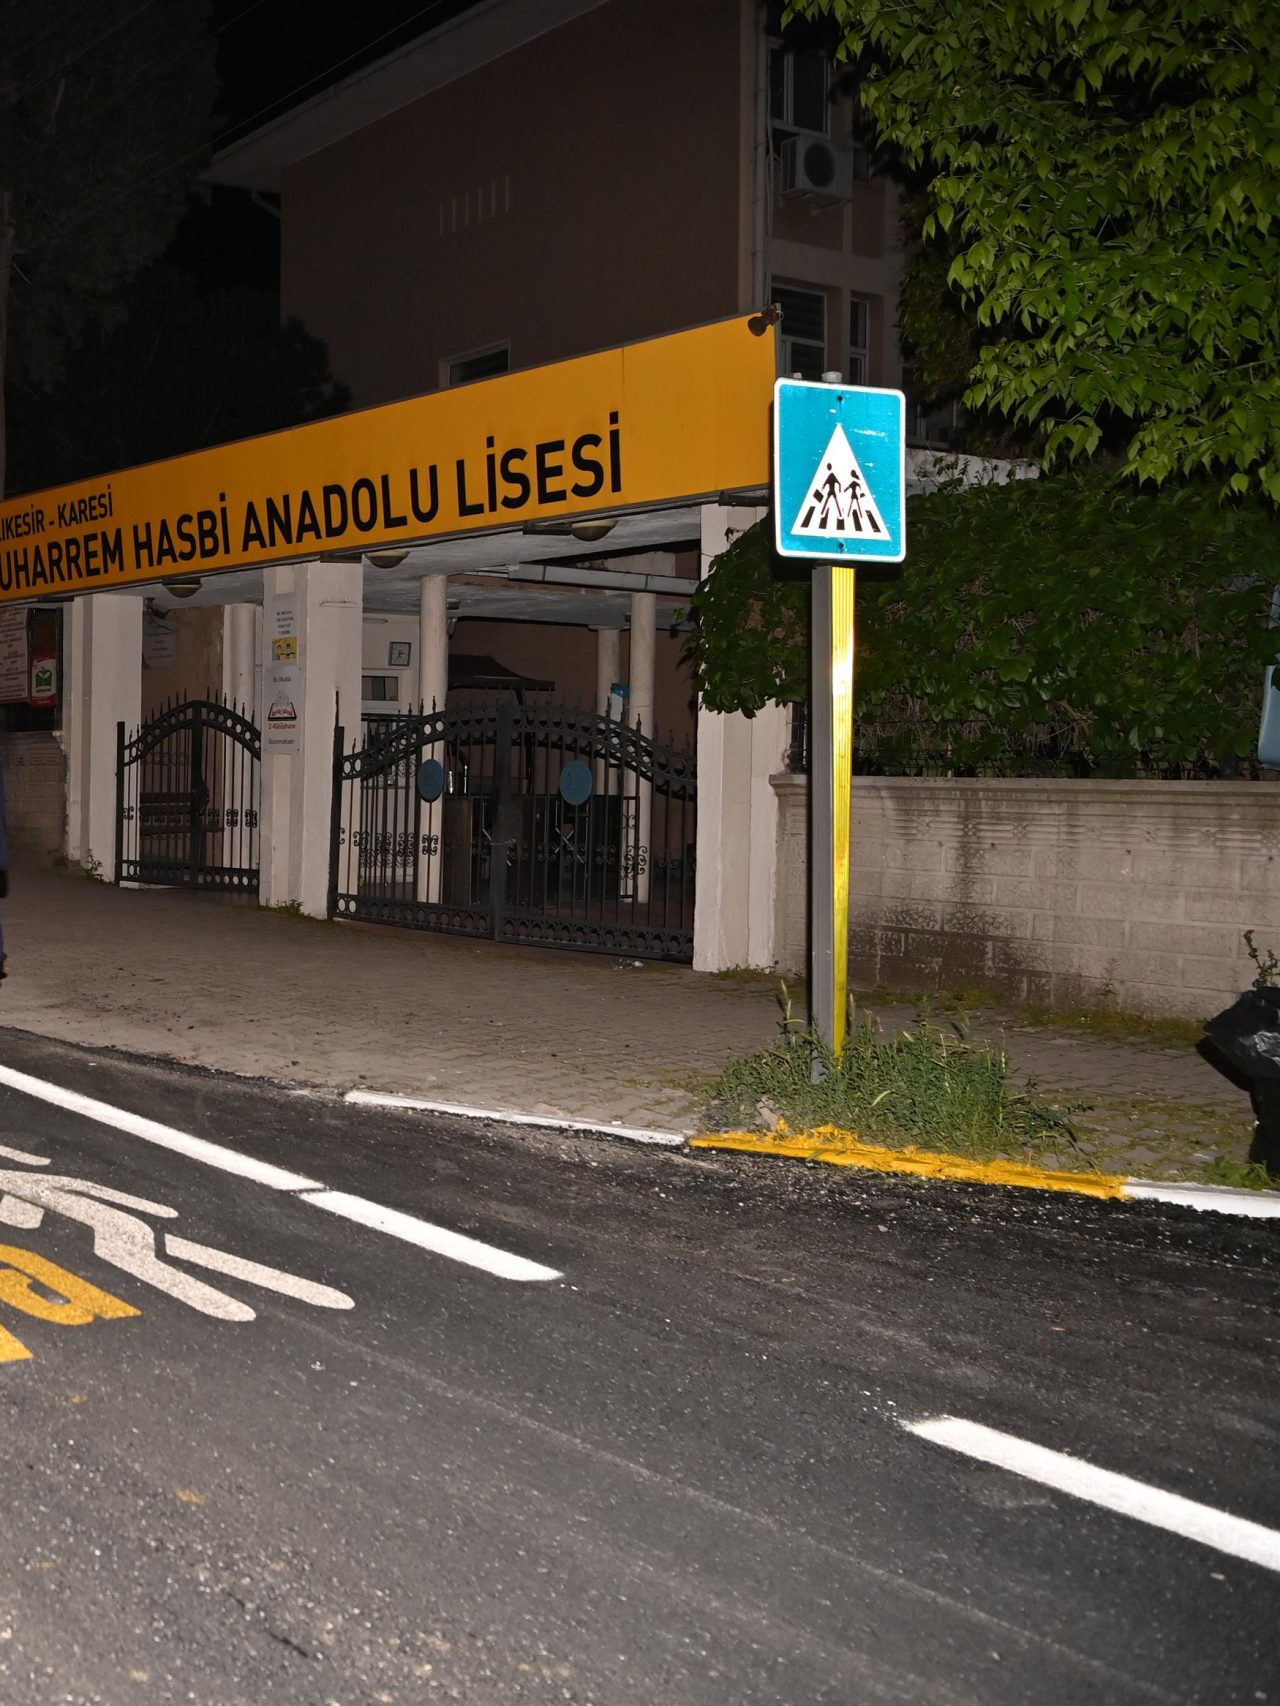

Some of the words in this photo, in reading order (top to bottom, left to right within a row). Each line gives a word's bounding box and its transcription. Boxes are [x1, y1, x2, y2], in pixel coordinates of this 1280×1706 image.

[57, 484, 113, 528] KARESİ
[132, 493, 231, 570] HASBİ
[242, 464, 439, 552] ANADOLU
[456, 411, 622, 517] LİSESİ
